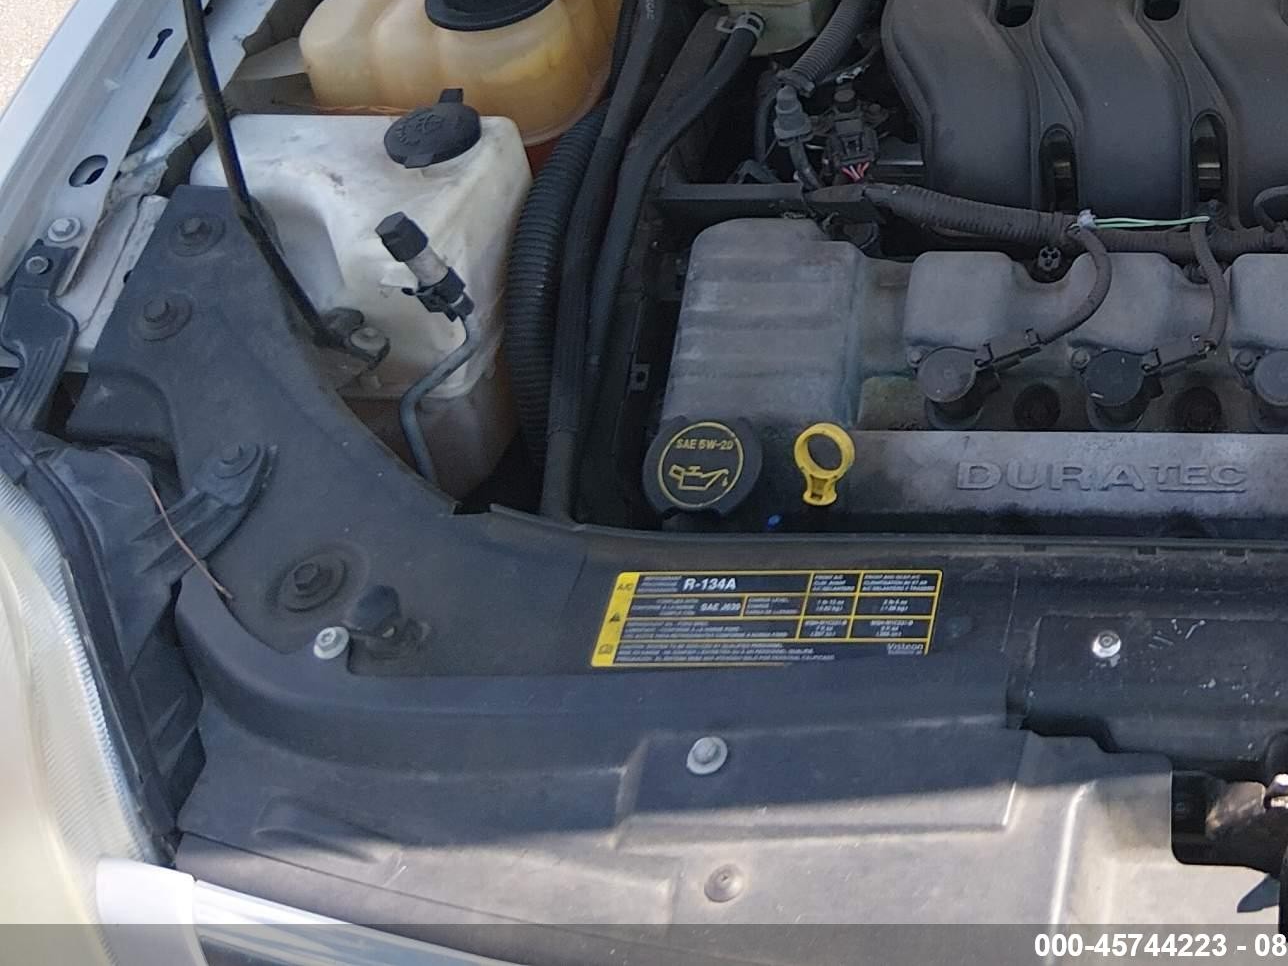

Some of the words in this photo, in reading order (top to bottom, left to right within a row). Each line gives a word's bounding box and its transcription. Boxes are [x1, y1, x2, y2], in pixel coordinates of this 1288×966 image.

[675, 438, 696, 449] SAE
[698, 439, 734, 450] 5W-20
[956, 459, 1248, 492] DURATEC
[682, 578, 737, 591] R-134A
[700, 603, 719, 611] SAE
[887, 643, 924, 651] Visteon
